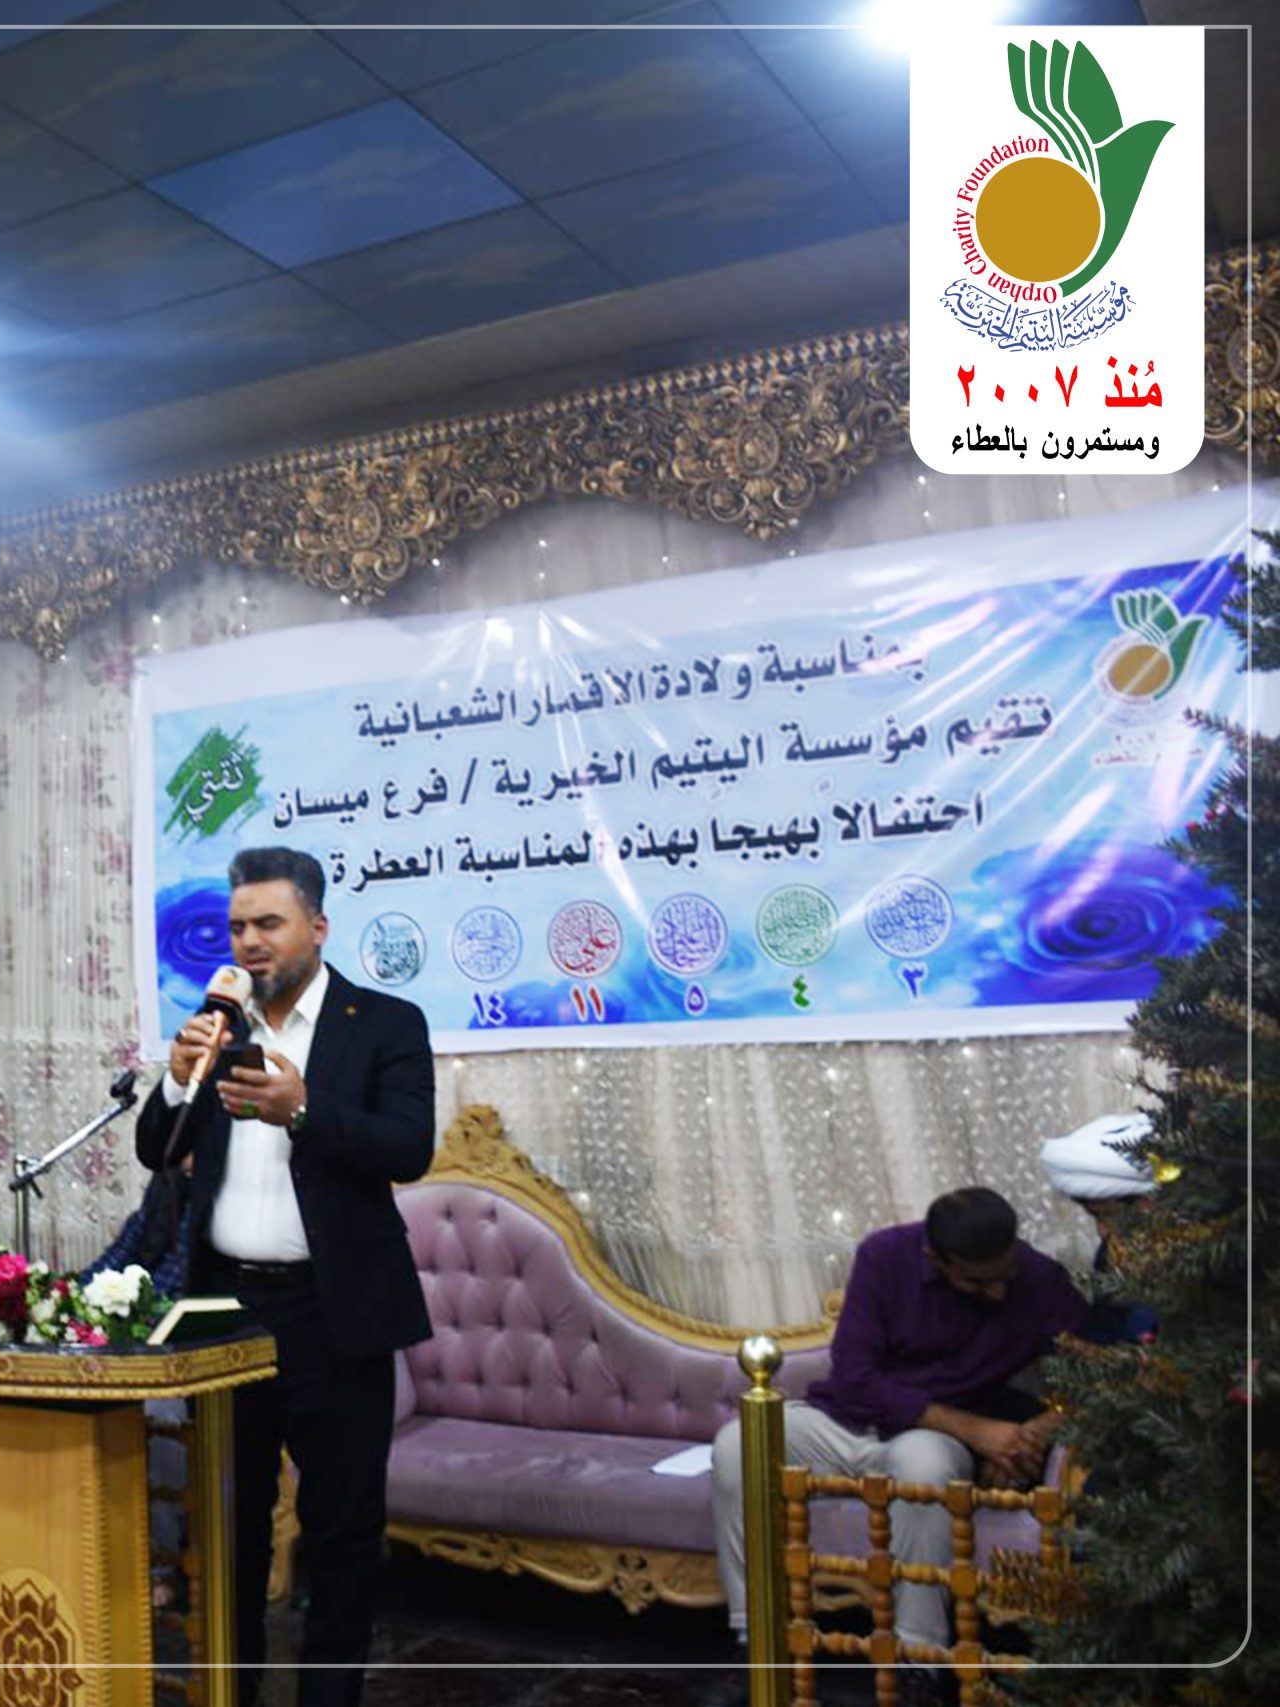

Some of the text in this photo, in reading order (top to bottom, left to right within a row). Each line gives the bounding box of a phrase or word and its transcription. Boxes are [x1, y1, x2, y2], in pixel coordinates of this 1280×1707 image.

[651, 657, 753, 701] ولادة
[355, 686, 517, 748] الشعبانية
[272, 696, 1054, 829] تقيم مؤسسة اليتيم الخيرية / فرع ميسان
[455, 828, 605, 883] لمناسبة
[618, 822, 699, 869] بهذه
[329, 847, 444, 893] العطرة
[474, 992, 503, 1023] ١٤
[572, 987, 603, 1020] ١١
[686, 984, 705, 1012] ٥
[792, 974, 810, 1008] ٤
